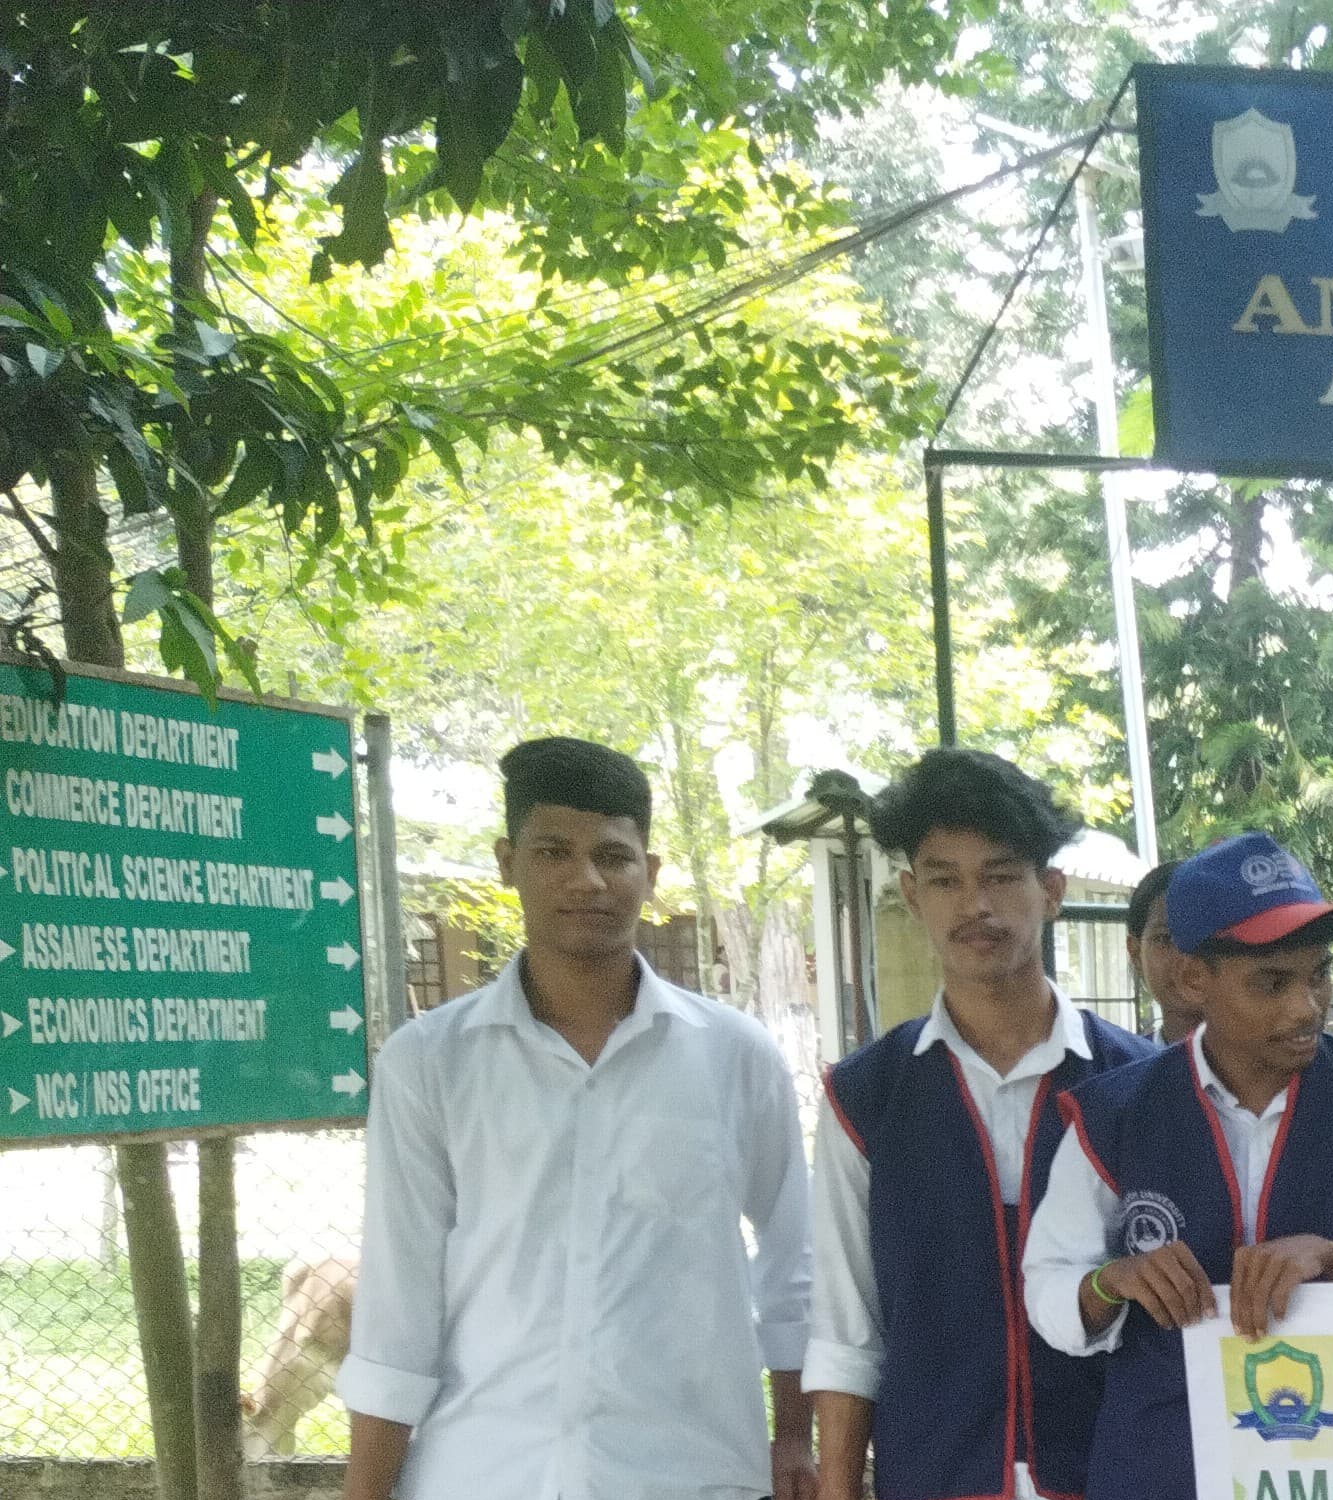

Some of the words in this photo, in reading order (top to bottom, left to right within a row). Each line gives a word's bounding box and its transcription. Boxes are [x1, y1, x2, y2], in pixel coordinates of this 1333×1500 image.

[0, 695, 118, 754] EDUCATION
[120, 711, 239, 771] DEPARTMENT
[6, 768, 122, 827] COMMERCE
[124, 783, 243, 839] DEPARTMENT
[12, 848, 120, 899] POLITICAL
[122, 855, 204, 904] SCIENCE
[205, 861, 314, 910] DEPARTMENT
[22, 923, 131, 971] ASSAMESE
[132, 928, 250, 973] DEPARTMENT
[28, 998, 149, 1044] ECONOMICS
[151, 999, 266, 1041] DEPARTMENT
[35, 1073, 78, 1119] NCC
[93, 1071, 130, 1115] NSS
[137, 1068, 201, 1114] OFFICE
